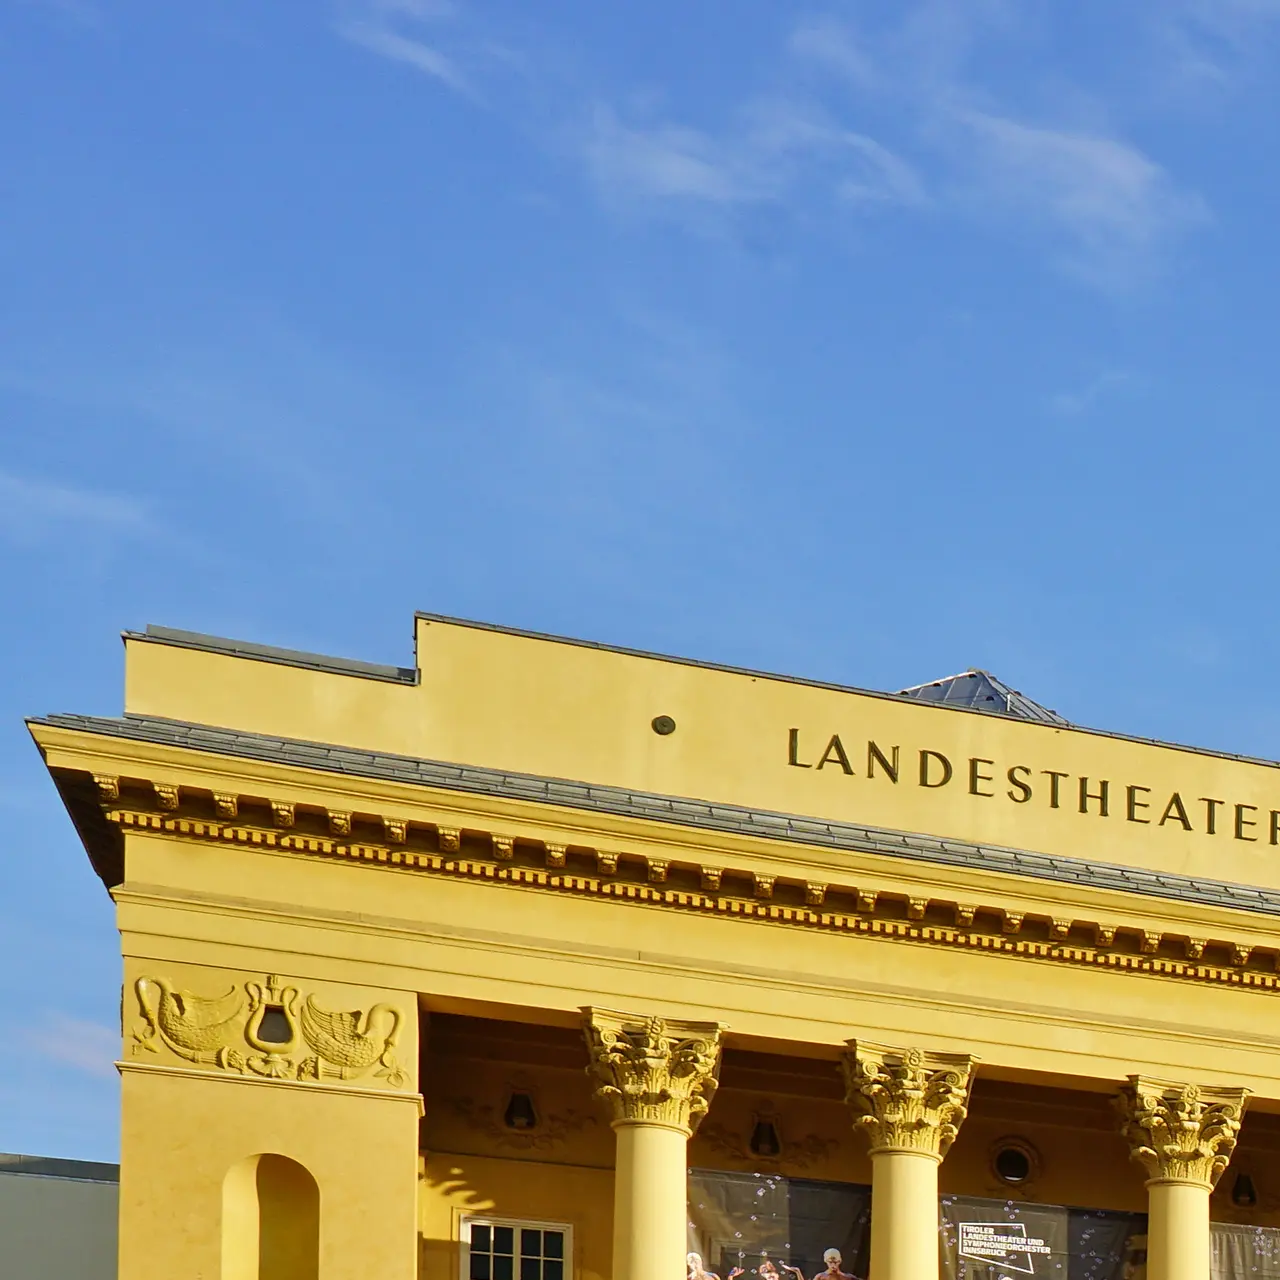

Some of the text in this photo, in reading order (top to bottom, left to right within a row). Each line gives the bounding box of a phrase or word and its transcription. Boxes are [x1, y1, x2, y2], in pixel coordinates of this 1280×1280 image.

[962, 1226, 994, 1234] TIROLER
[963, 1233, 1026, 1244] LANDESTHEATER
[963, 1240, 1051, 1254] SYMPHONIEORCHESTER
[963, 1247, 1006, 1256] INNSBRUCK
